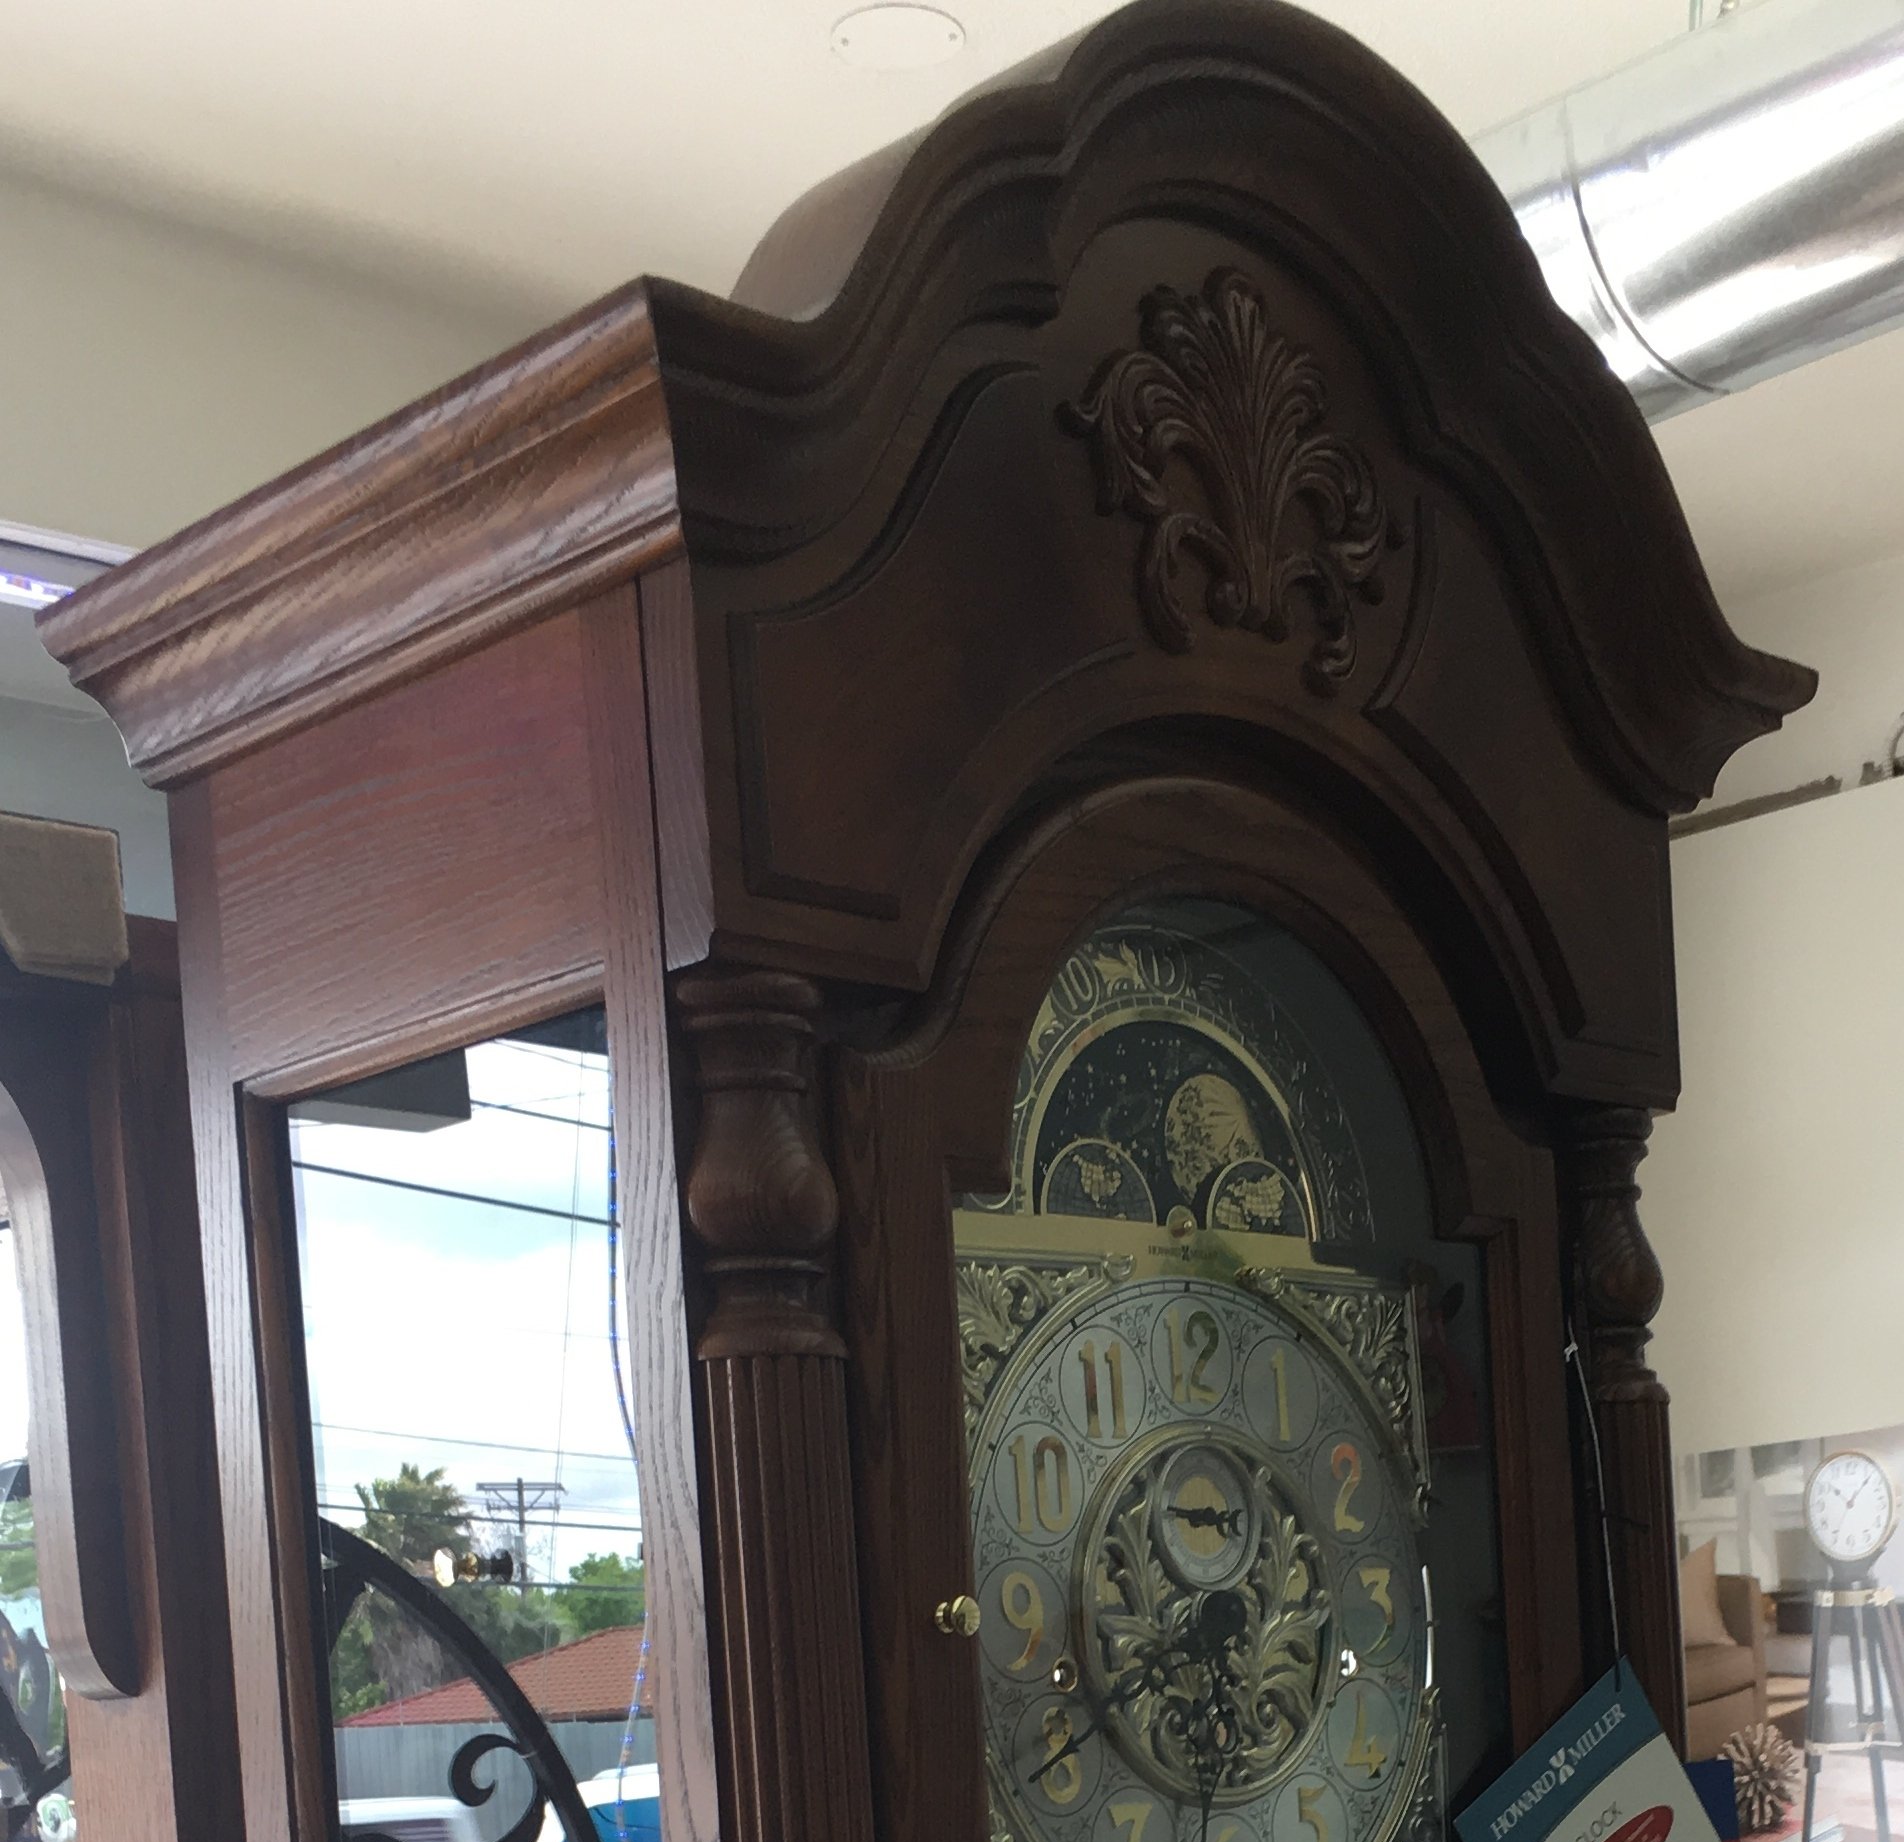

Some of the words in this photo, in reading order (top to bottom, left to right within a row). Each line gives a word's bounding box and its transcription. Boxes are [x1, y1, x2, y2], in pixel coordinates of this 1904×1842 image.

[1058, 957, 1094, 1011] 10
[1079, 1338, 1129, 1440] 11
[1162, 1307, 1220, 1403] 12
[1269, 1347, 1291, 1442] 1
[1008, 1434, 1070, 1535] 10
[1330, 1441, 1365, 1534] 2
[1002, 1571, 1044, 1671] 9
[1356, 1567, 1394, 1655] 3
[1041, 1706, 1082, 1804] 8
[1343, 1694, 1388, 1779] 4
[1490, 1769, 1556, 1841] HOWARD
[1567, 1703, 1626, 1765] MILLER
